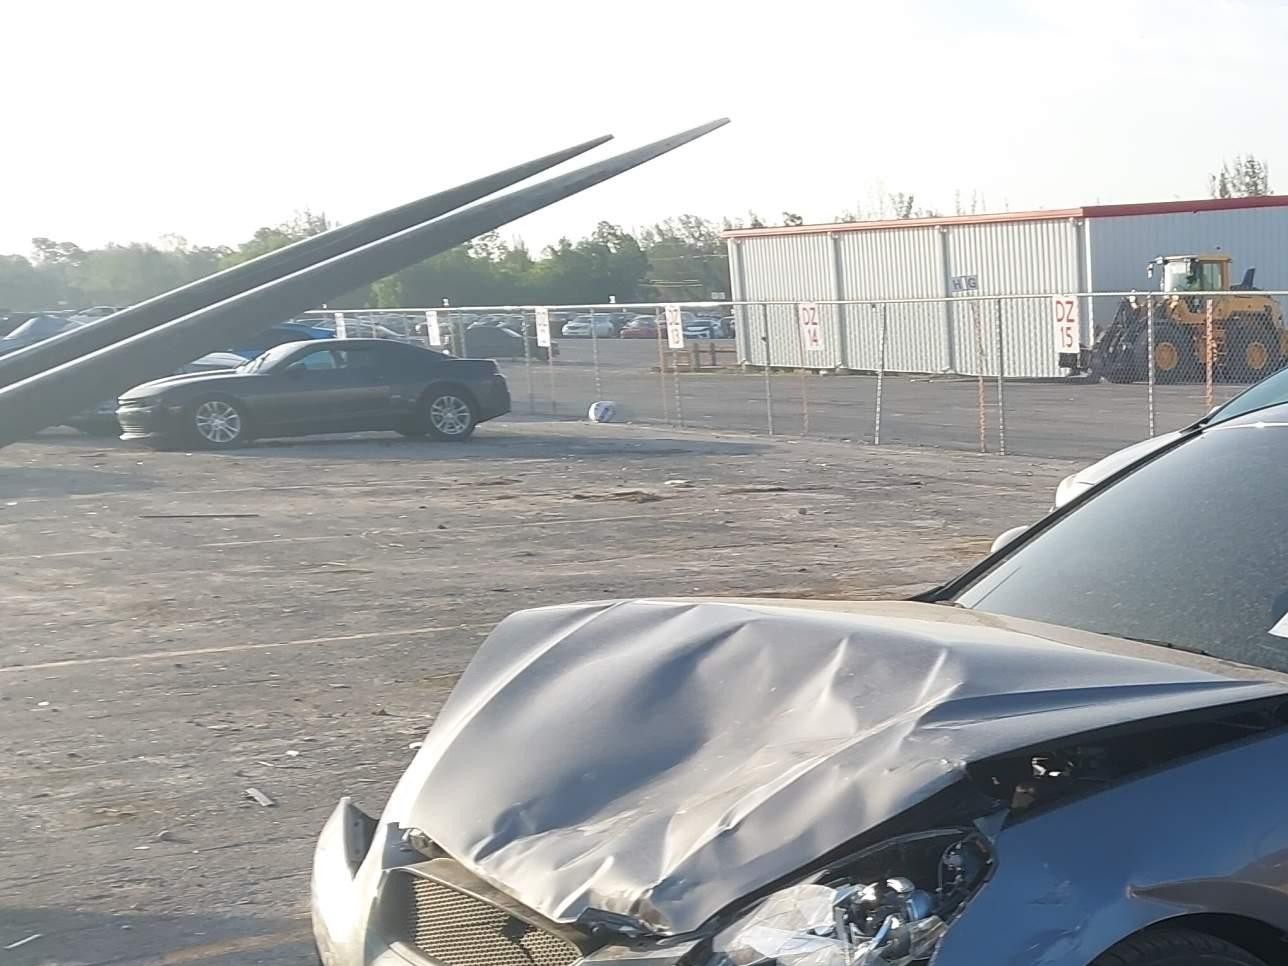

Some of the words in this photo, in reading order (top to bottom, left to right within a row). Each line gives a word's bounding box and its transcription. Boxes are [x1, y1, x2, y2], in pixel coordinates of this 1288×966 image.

[802, 307, 818, 325] DZ
[1055, 300, 1075, 322] DZ
[1060, 326, 1073, 348] 15
